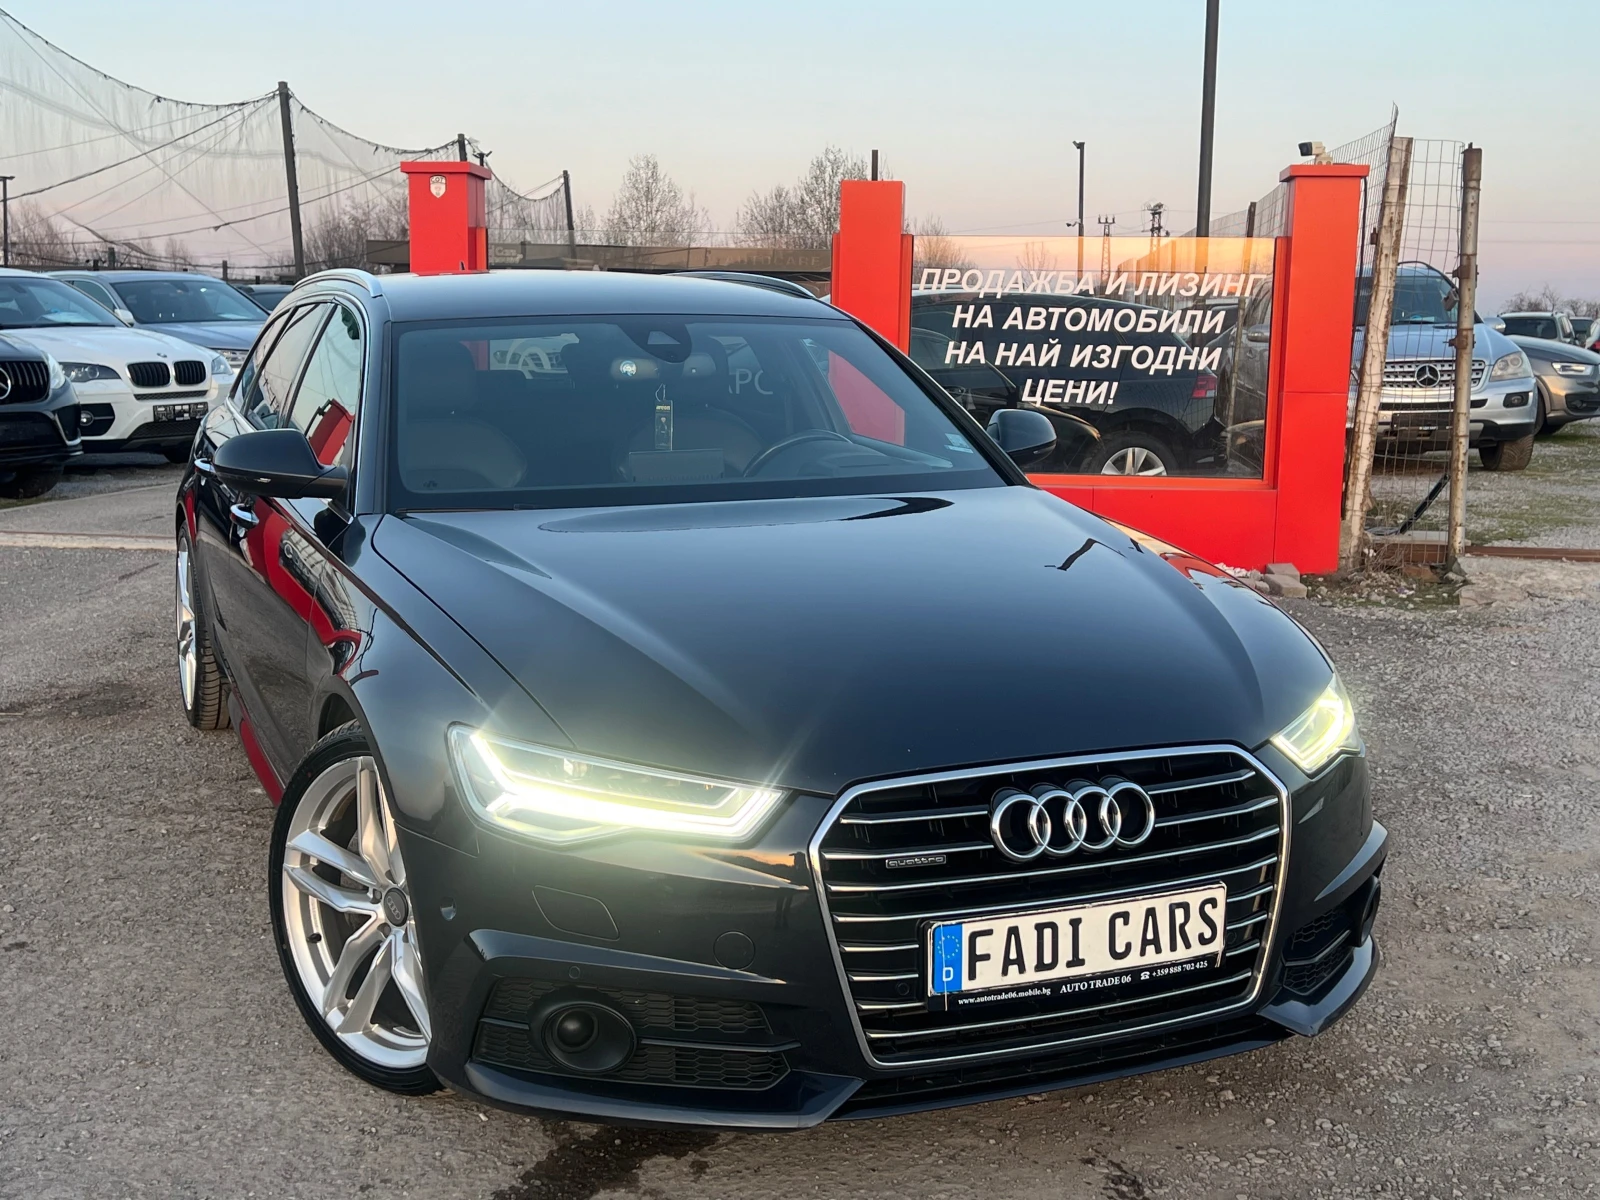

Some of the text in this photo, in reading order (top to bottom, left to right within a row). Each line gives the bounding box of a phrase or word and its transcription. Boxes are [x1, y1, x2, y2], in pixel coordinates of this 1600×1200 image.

[919, 268, 1269, 298] ПРОДАЖБА И ЛИЗИНГ
[952, 304, 1226, 334] НА АВТОМОБИЛИ
[944, 338, 1222, 375] НА НАЙ ИЗГОДНИ
[1021, 378, 1118, 408] ЦЕНИ!
[888, 856, 944, 867] quattro
[968, 897, 1218, 981] FADI CARS
[942, 967, 954, 982] D
[1152, 960, 1208, 978] +359 888 702 425
[958, 986, 1051, 1005] www.autotrade06.mobile.bg
[1060, 974, 1132, 994] AUTO TRADE 06
